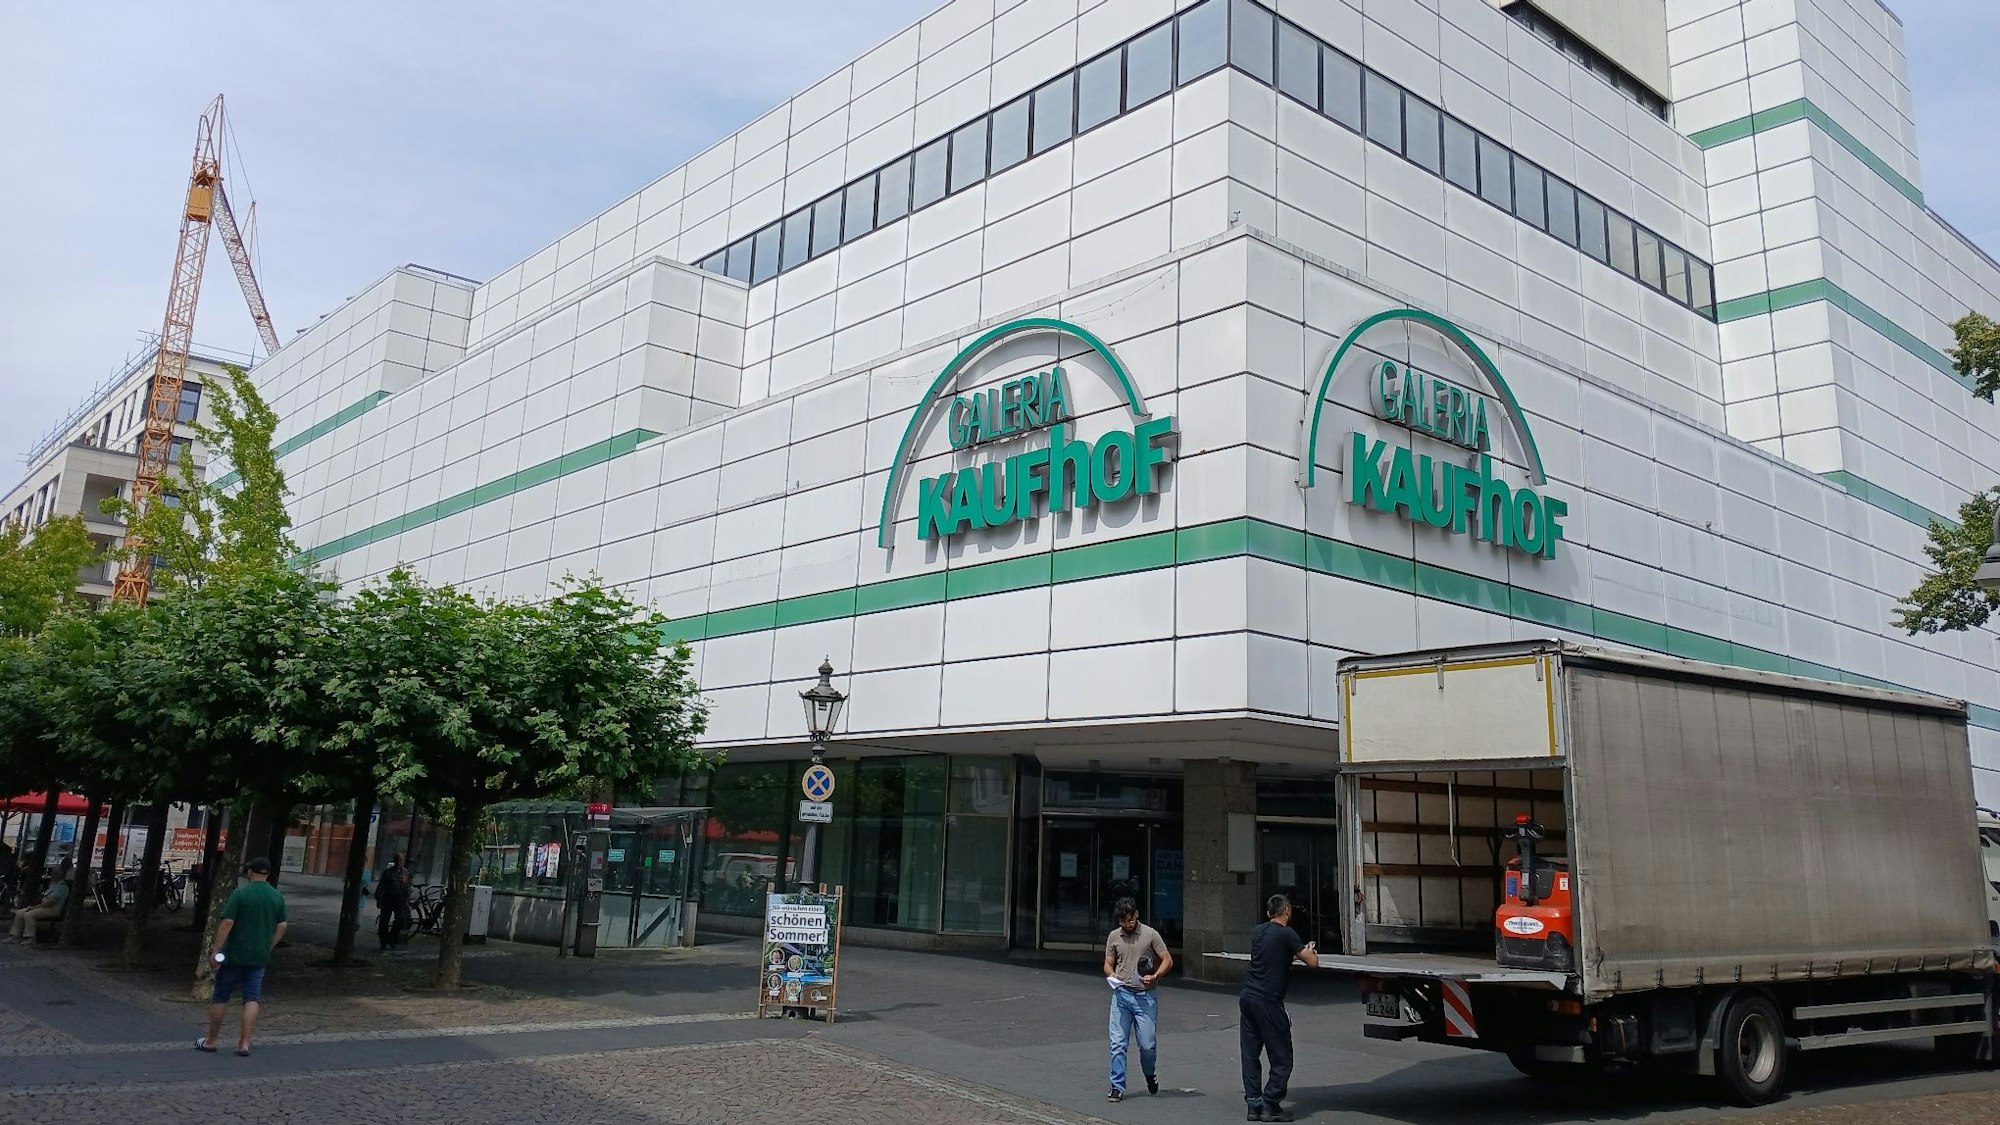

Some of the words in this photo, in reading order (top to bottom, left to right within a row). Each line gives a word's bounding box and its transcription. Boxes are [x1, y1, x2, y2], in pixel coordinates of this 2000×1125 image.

[949, 366, 1072, 450] GALERIA
[1373, 361, 1491, 451] GALERIA
[770, 928, 826, 942] Sommer!
[771, 913, 822, 927] schönen
